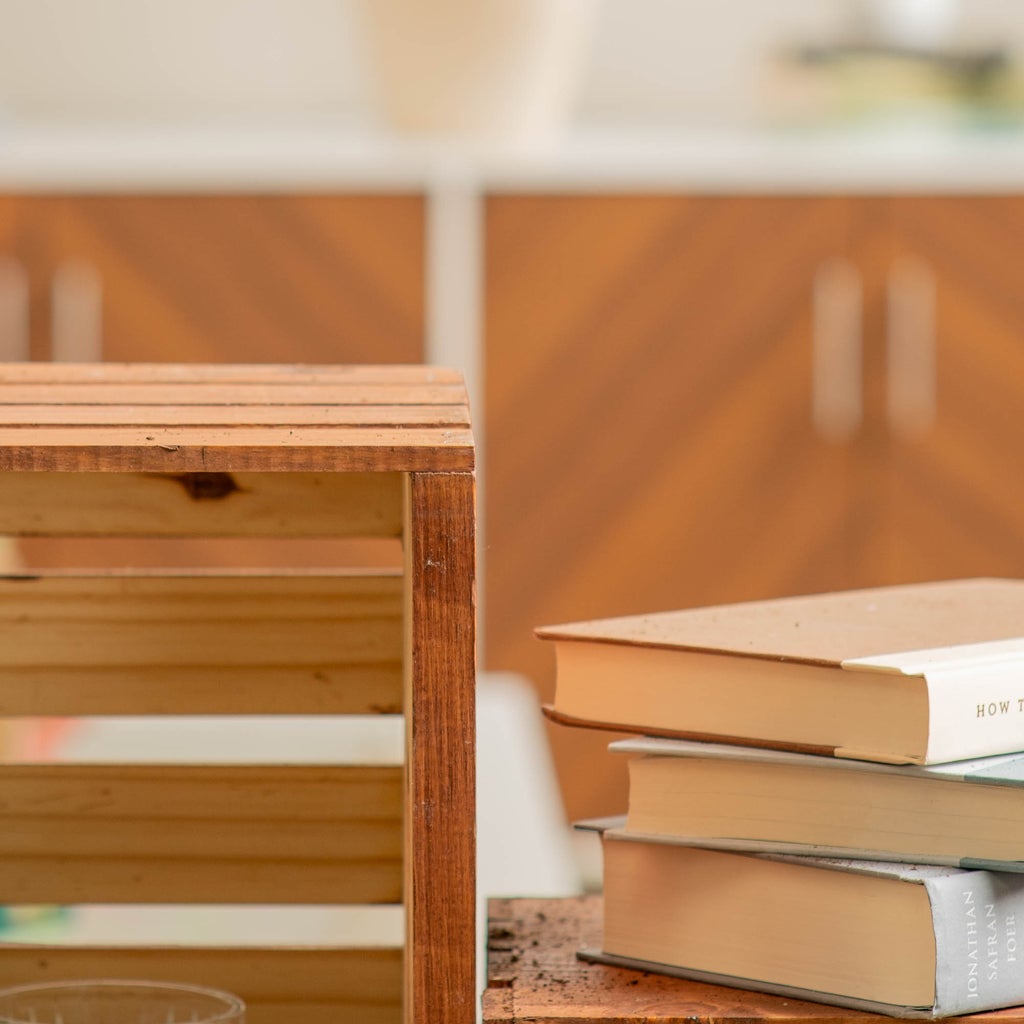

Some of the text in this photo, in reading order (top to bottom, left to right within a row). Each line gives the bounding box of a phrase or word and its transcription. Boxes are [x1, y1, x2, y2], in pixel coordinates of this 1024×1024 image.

[976, 700, 1010, 718] HOW
[962, 890, 979, 998] JONATHAN
[984, 903, 998, 981] SAFRAN
[1005, 912, 1017, 962] FOER
